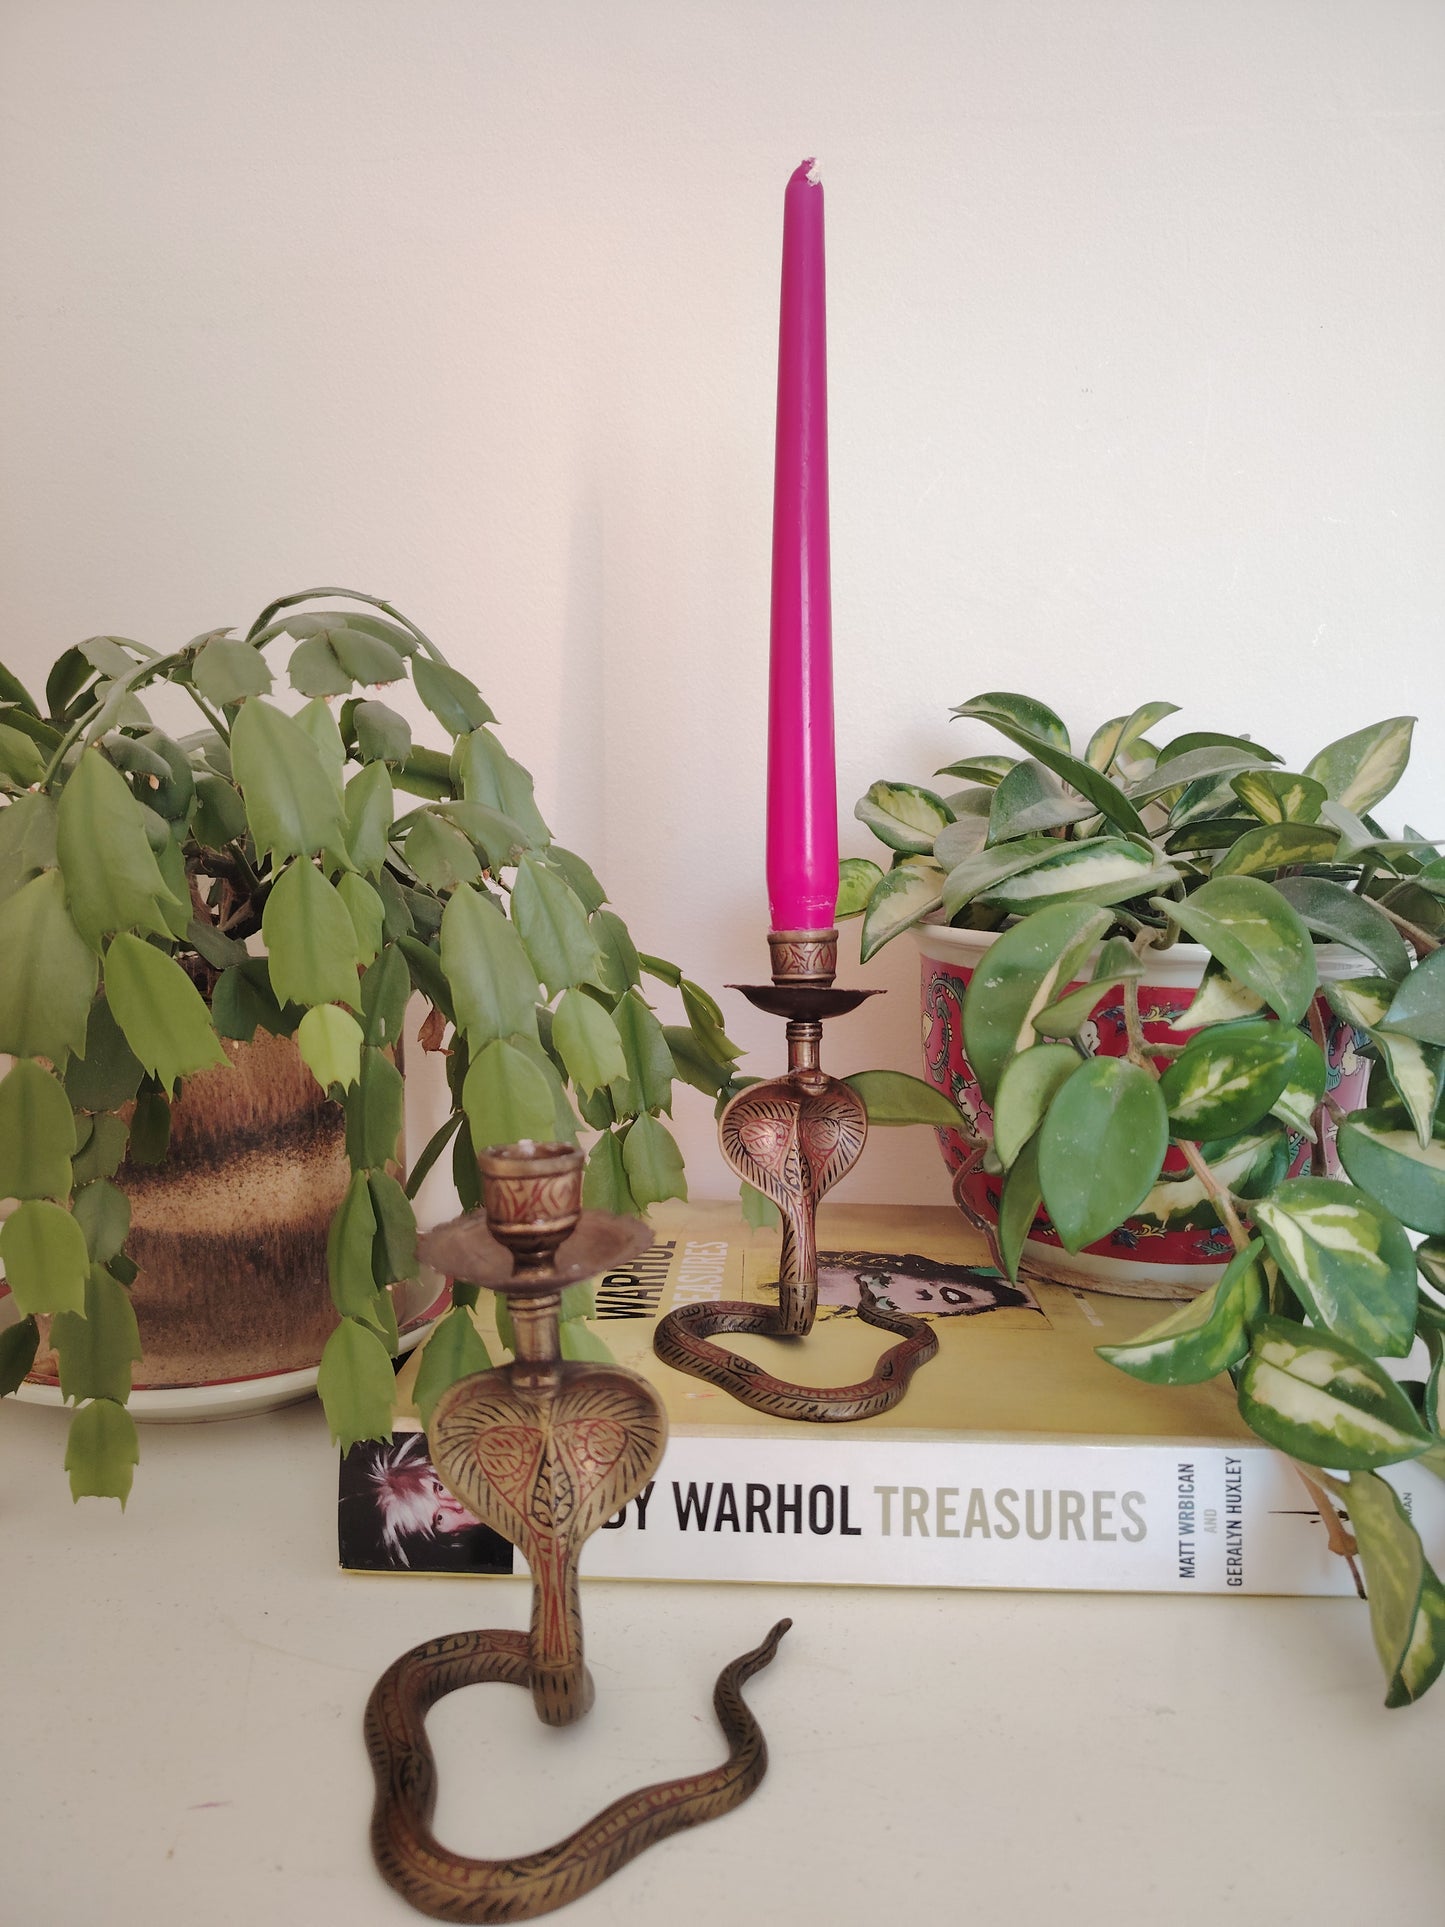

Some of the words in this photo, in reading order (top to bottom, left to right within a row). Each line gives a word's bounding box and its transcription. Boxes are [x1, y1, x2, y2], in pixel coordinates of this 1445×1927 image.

[671, 1481, 862, 1536] WARHOL
[873, 1485, 1148, 1543] TREASURES
[1178, 1463, 1195, 1536] WRBICAN
[1225, 1456, 1242, 1514] HUXLEY
[1203, 1508, 1218, 1534] AND
[1178, 1540, 1195, 1579] MATT
[1226, 1519, 1243, 1587] GERALYN
